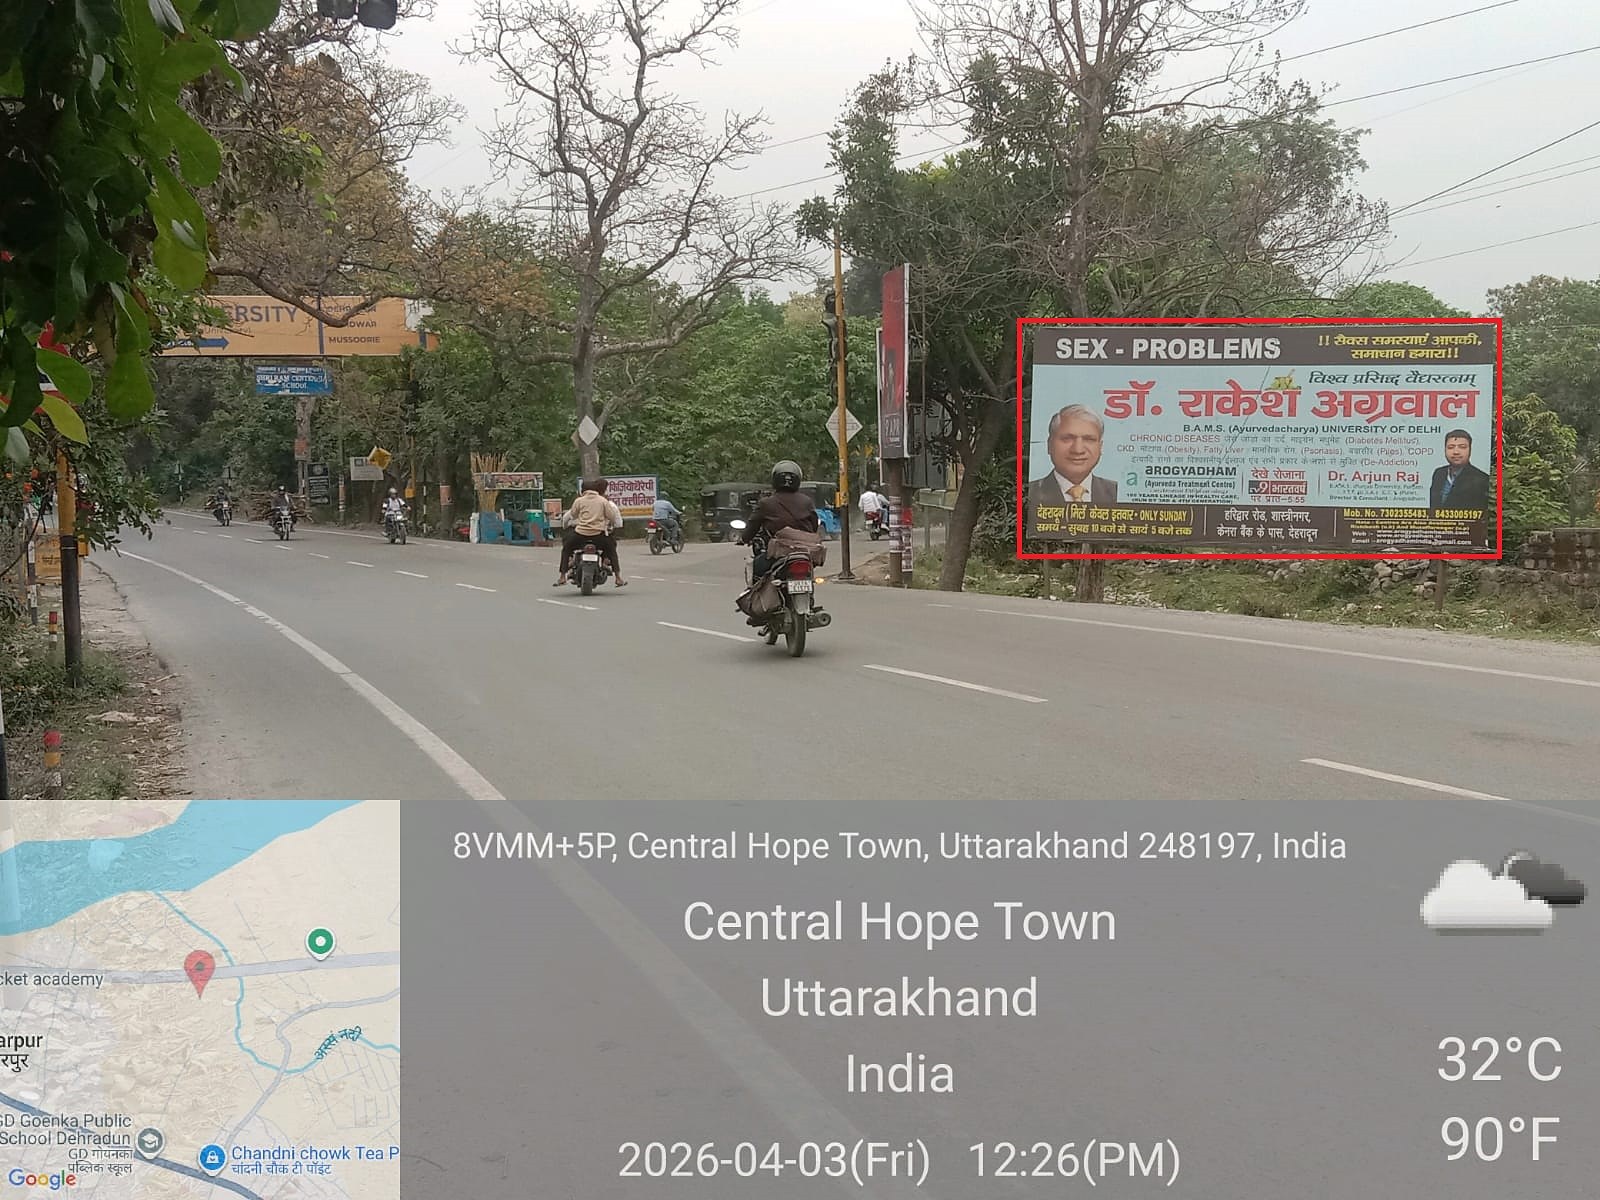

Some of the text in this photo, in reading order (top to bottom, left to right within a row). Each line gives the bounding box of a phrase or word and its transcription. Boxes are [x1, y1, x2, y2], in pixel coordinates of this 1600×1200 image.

[328, 336, 381, 344] MUSSOORIE
[1056, 338, 1108, 359] SEX
[1132, 337, 1281, 359] PROBLEMS
[1309, 371, 1349, 384] विश्व
[1103, 379, 1480, 424] डॉ. राकेश अग्रवाल
[1183, 424, 1441, 435] B.A.M.S. (Ayurvedacharya) UNIVERSITY OF DELHI
[1129, 434, 1172, 442] CHRONIC
[1174, 434, 1221, 443] DISEASES
[1273, 467, 1306, 480] रोजाना
[1328, 470, 1420, 484] Dr. Arjun Raj
[1036, 503, 1065, 523] देहरादून
[1139, 509, 1157, 521] ONLY
[1159, 510, 1187, 522] SUNDAY
[1343, 508, 1363, 517] Mob.
[1364, 509, 1378, 517] No.
[1435, 510, 1483, 520] 8433005197
[1175, 526, 1193, 535] तक
[1287, 525, 1318, 543] देहरादून
